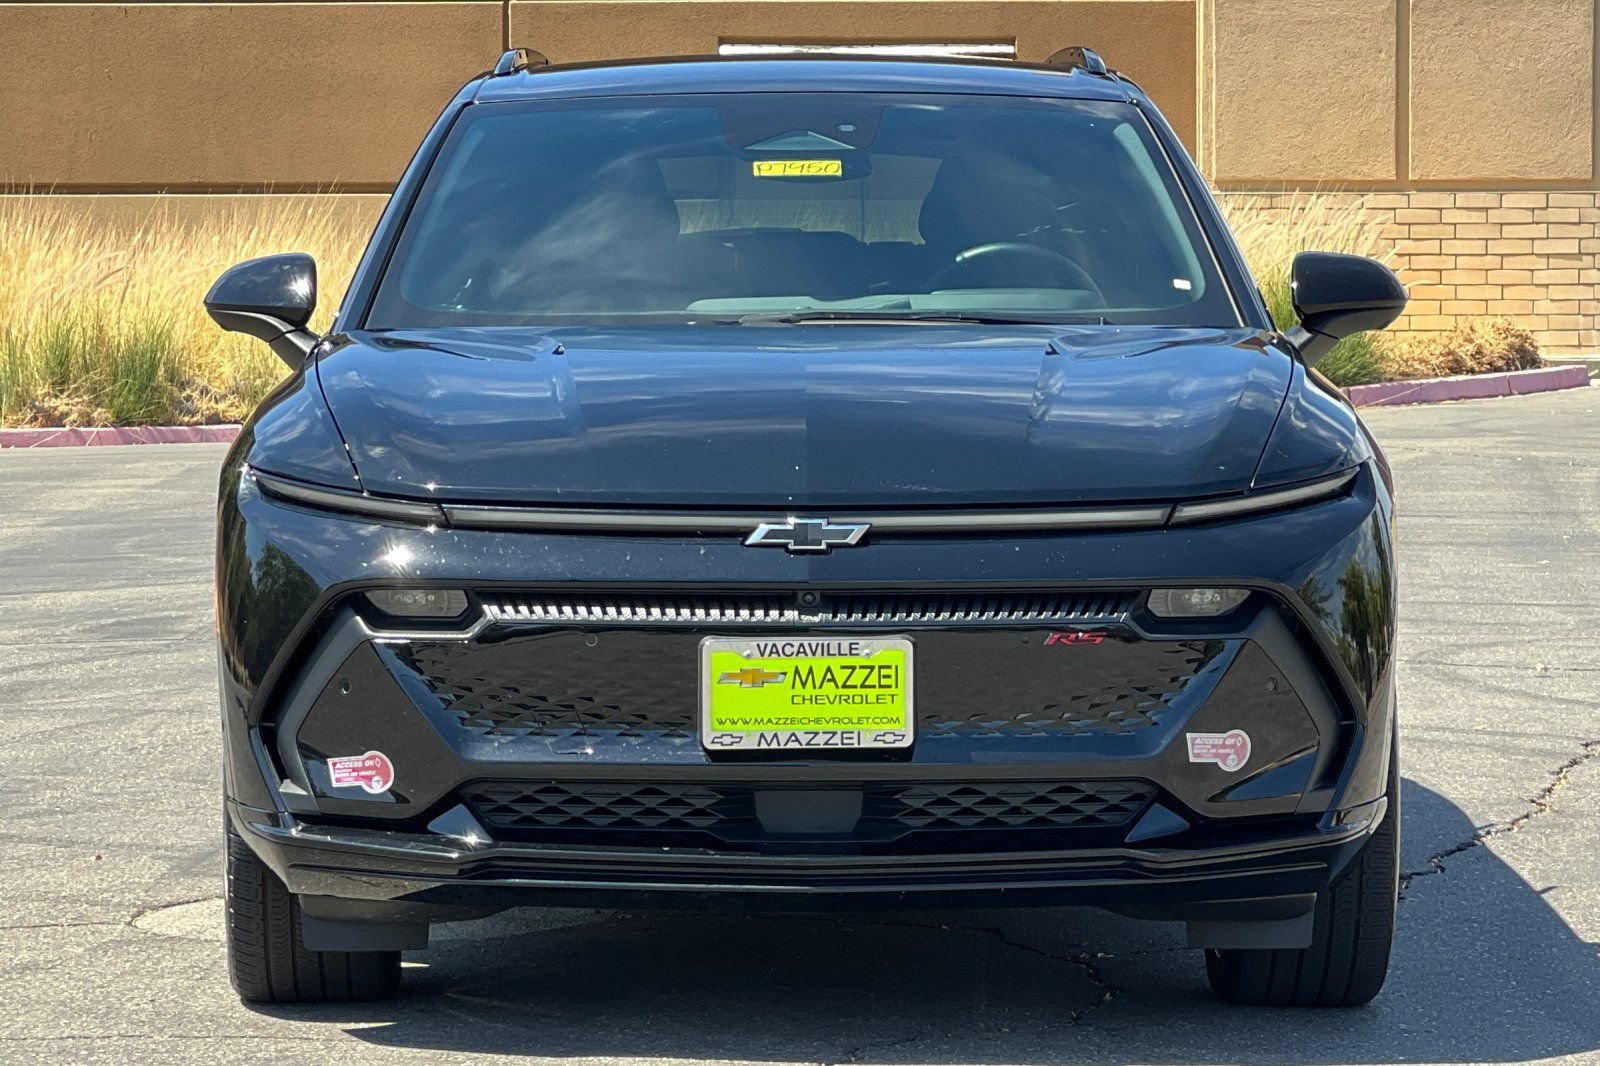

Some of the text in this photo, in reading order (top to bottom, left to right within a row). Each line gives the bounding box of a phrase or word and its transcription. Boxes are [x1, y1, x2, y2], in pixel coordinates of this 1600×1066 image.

[1044, 632, 1106, 645] RS
[757, 642, 860, 657] VACAVILLE
[791, 664, 899, 690] MAZZEI
[791, 694, 899, 706] CHEVROLET
[716, 716, 900, 726] WWW.MAZZEICHEVROLET.COM
[757, 731, 861, 747] MAZZEI
[1194, 737, 1224, 745] ACCESS
[335, 760, 363, 769] ACCESS
